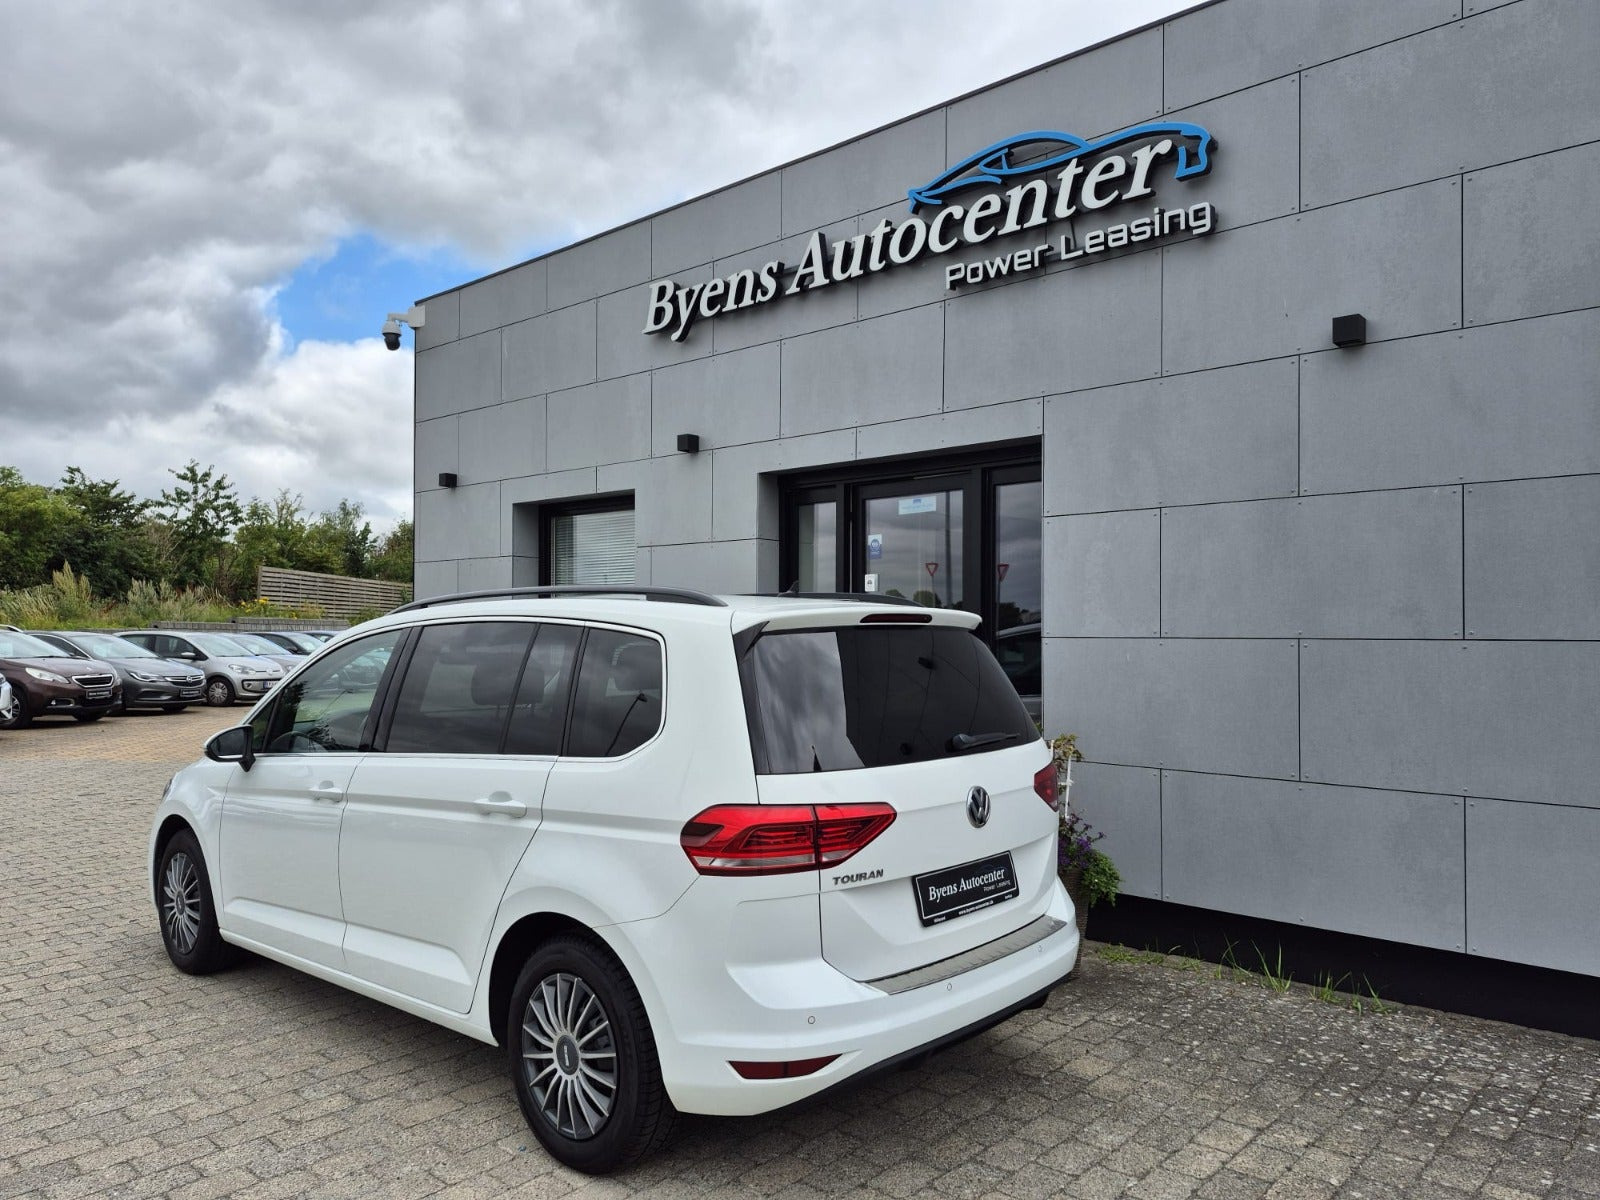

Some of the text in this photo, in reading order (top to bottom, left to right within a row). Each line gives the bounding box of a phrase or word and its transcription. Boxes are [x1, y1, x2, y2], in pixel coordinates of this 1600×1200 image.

[642, 139, 1173, 342] Byens Autocenter
[946, 201, 1212, 290] Power Leasing
[833, 869, 884, 885] TOURAN
[929, 869, 1005, 903] Byens Autocenter
